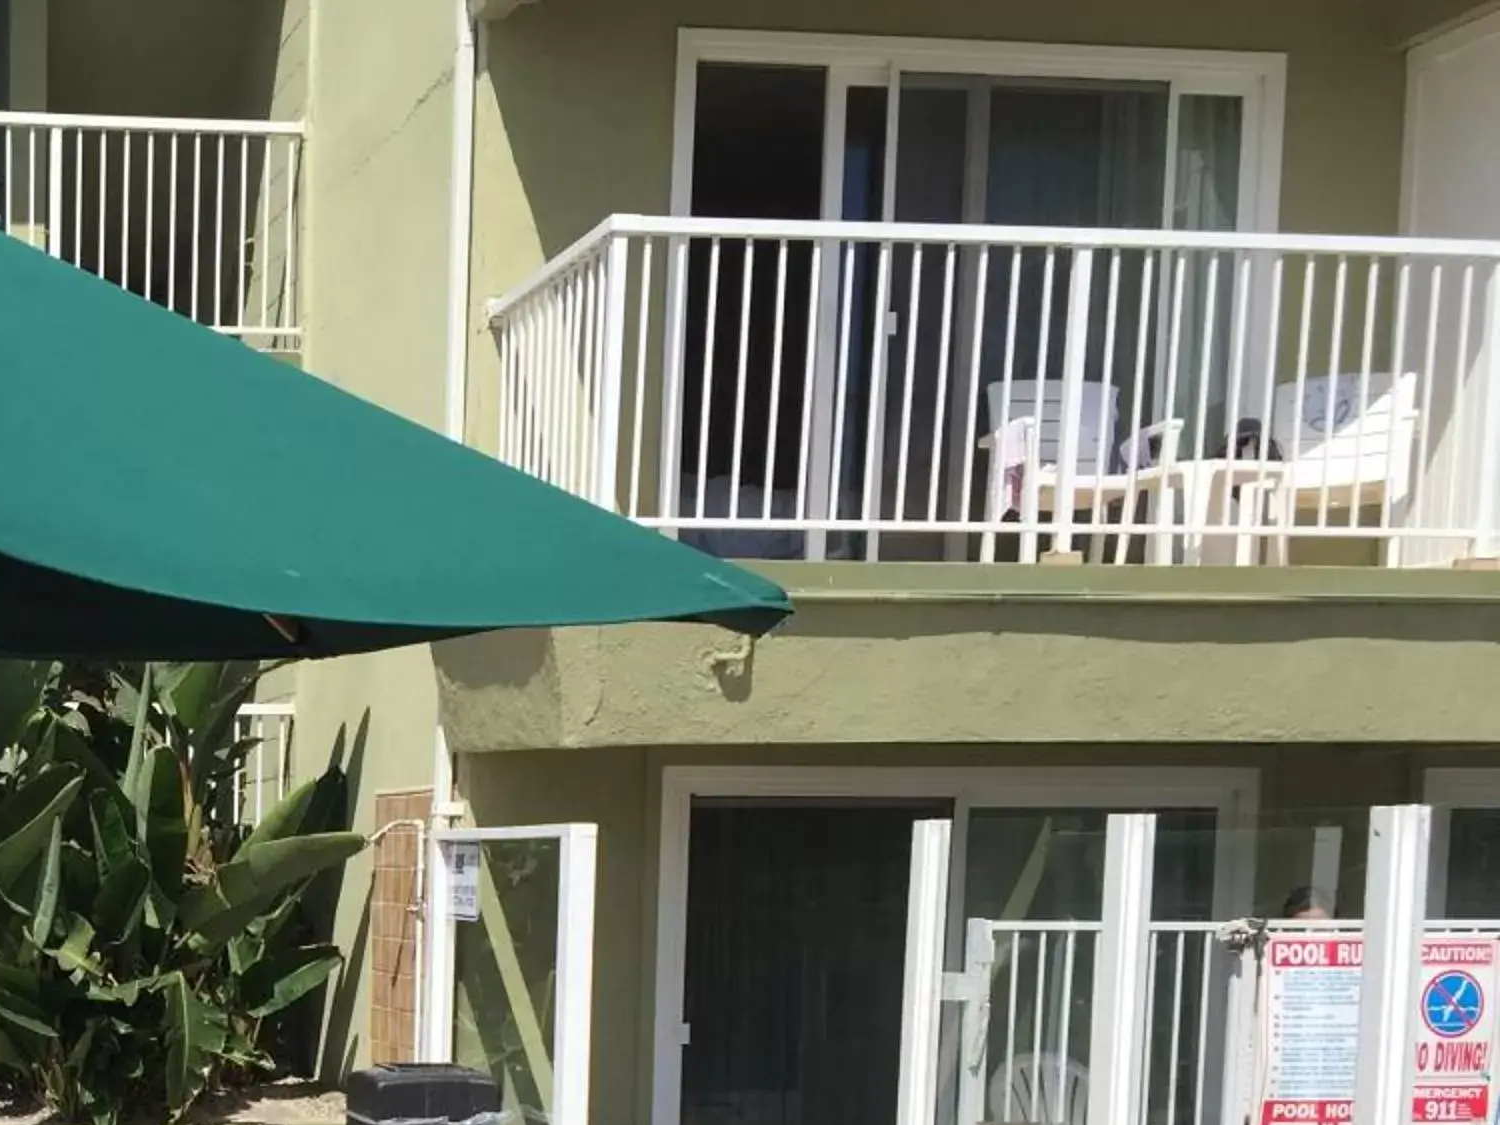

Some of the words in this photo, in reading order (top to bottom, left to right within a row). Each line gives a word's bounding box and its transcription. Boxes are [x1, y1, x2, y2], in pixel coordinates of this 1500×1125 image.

[1275, 943, 1329, 965] POOL
[1415, 1042, 1428, 1071] O
[1434, 1042, 1488, 1071] DIVING!
[1272, 1103, 1320, 1119] POOL
[1325, 1103, 1353, 1119] HO
[1425, 1100, 1457, 1120] 911
